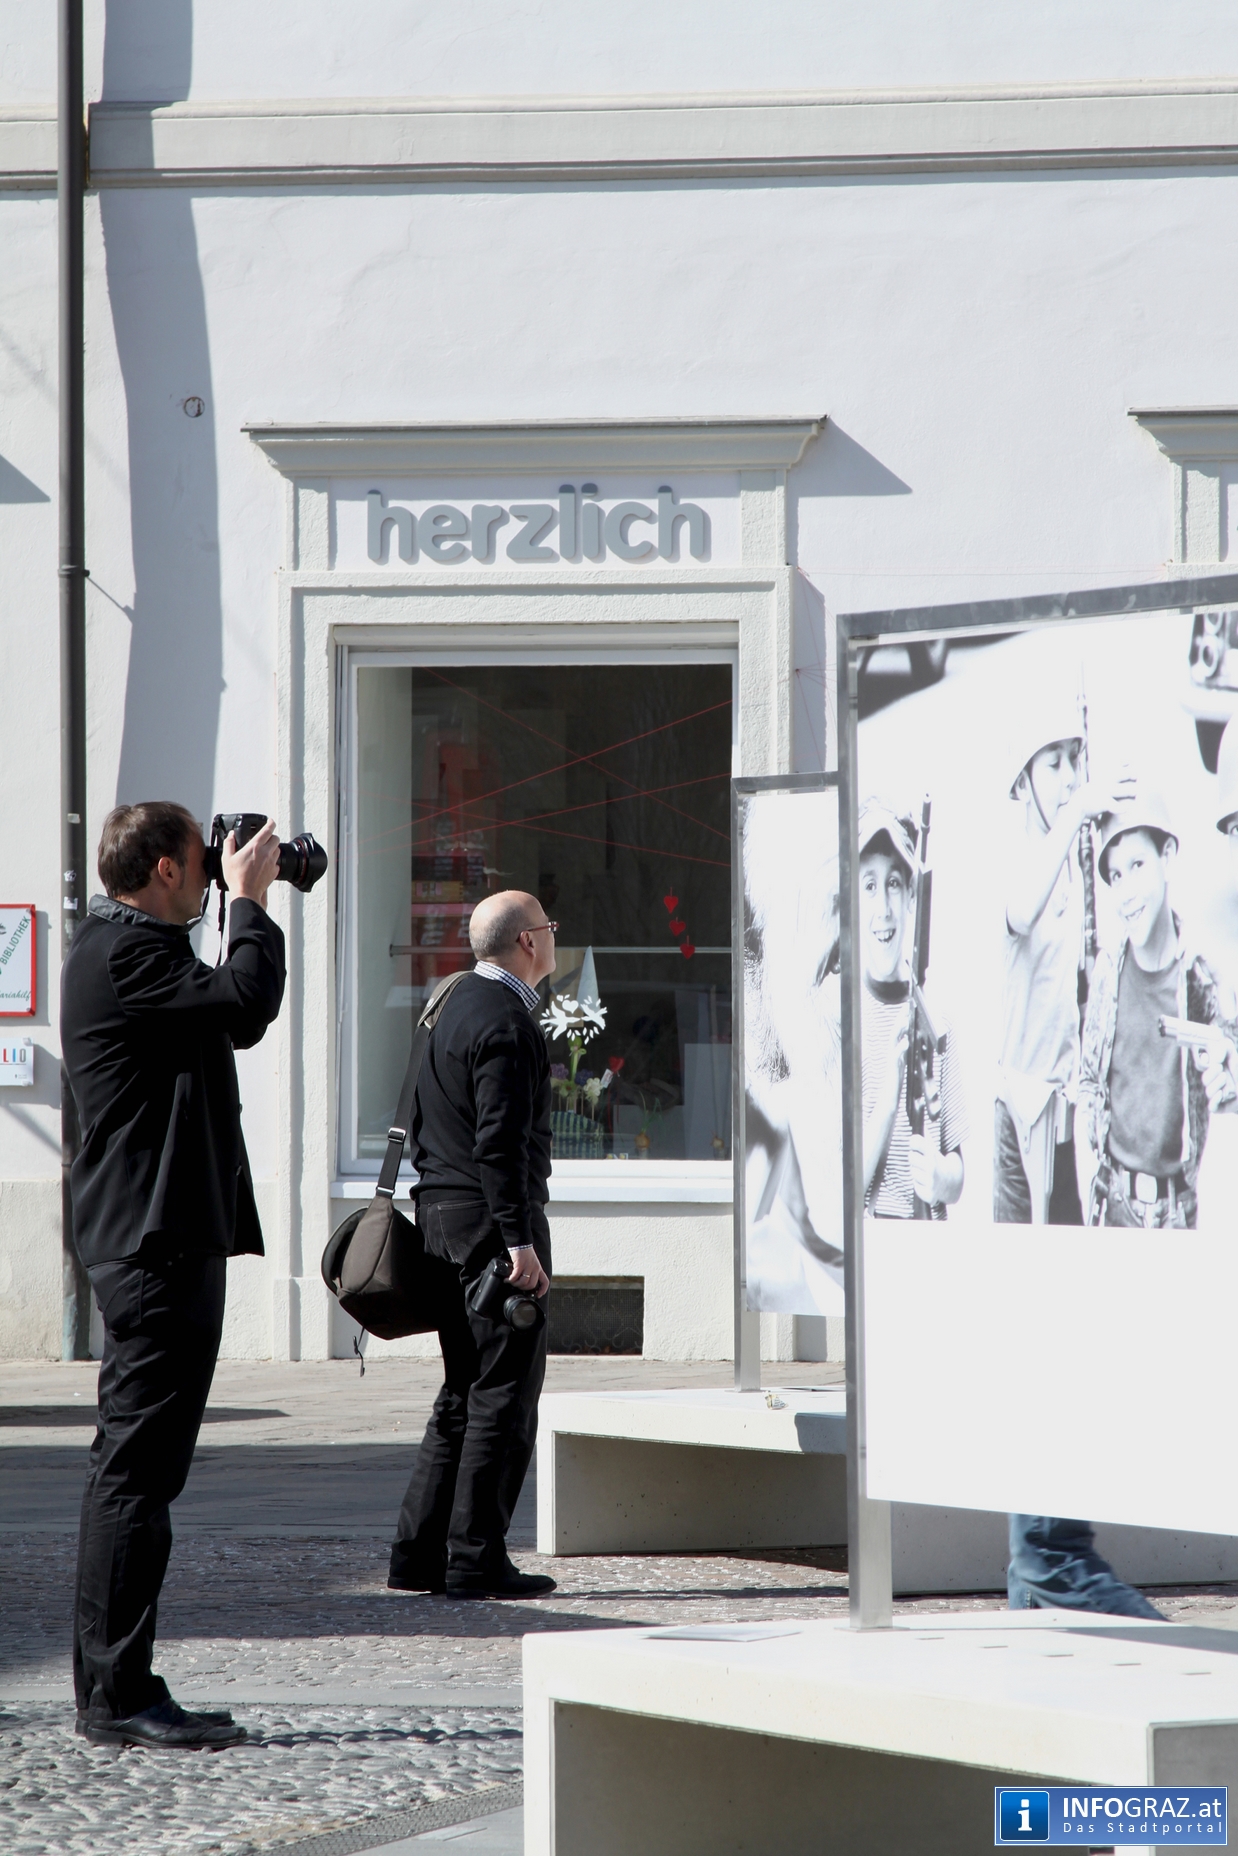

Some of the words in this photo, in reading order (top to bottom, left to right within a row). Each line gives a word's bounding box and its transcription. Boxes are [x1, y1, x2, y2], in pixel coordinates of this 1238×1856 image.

[366, 482, 706, 562] herzlich
[0, 915, 31, 965] BIBLIOTHEK
[0, 990, 31, 1001] ariahilf
